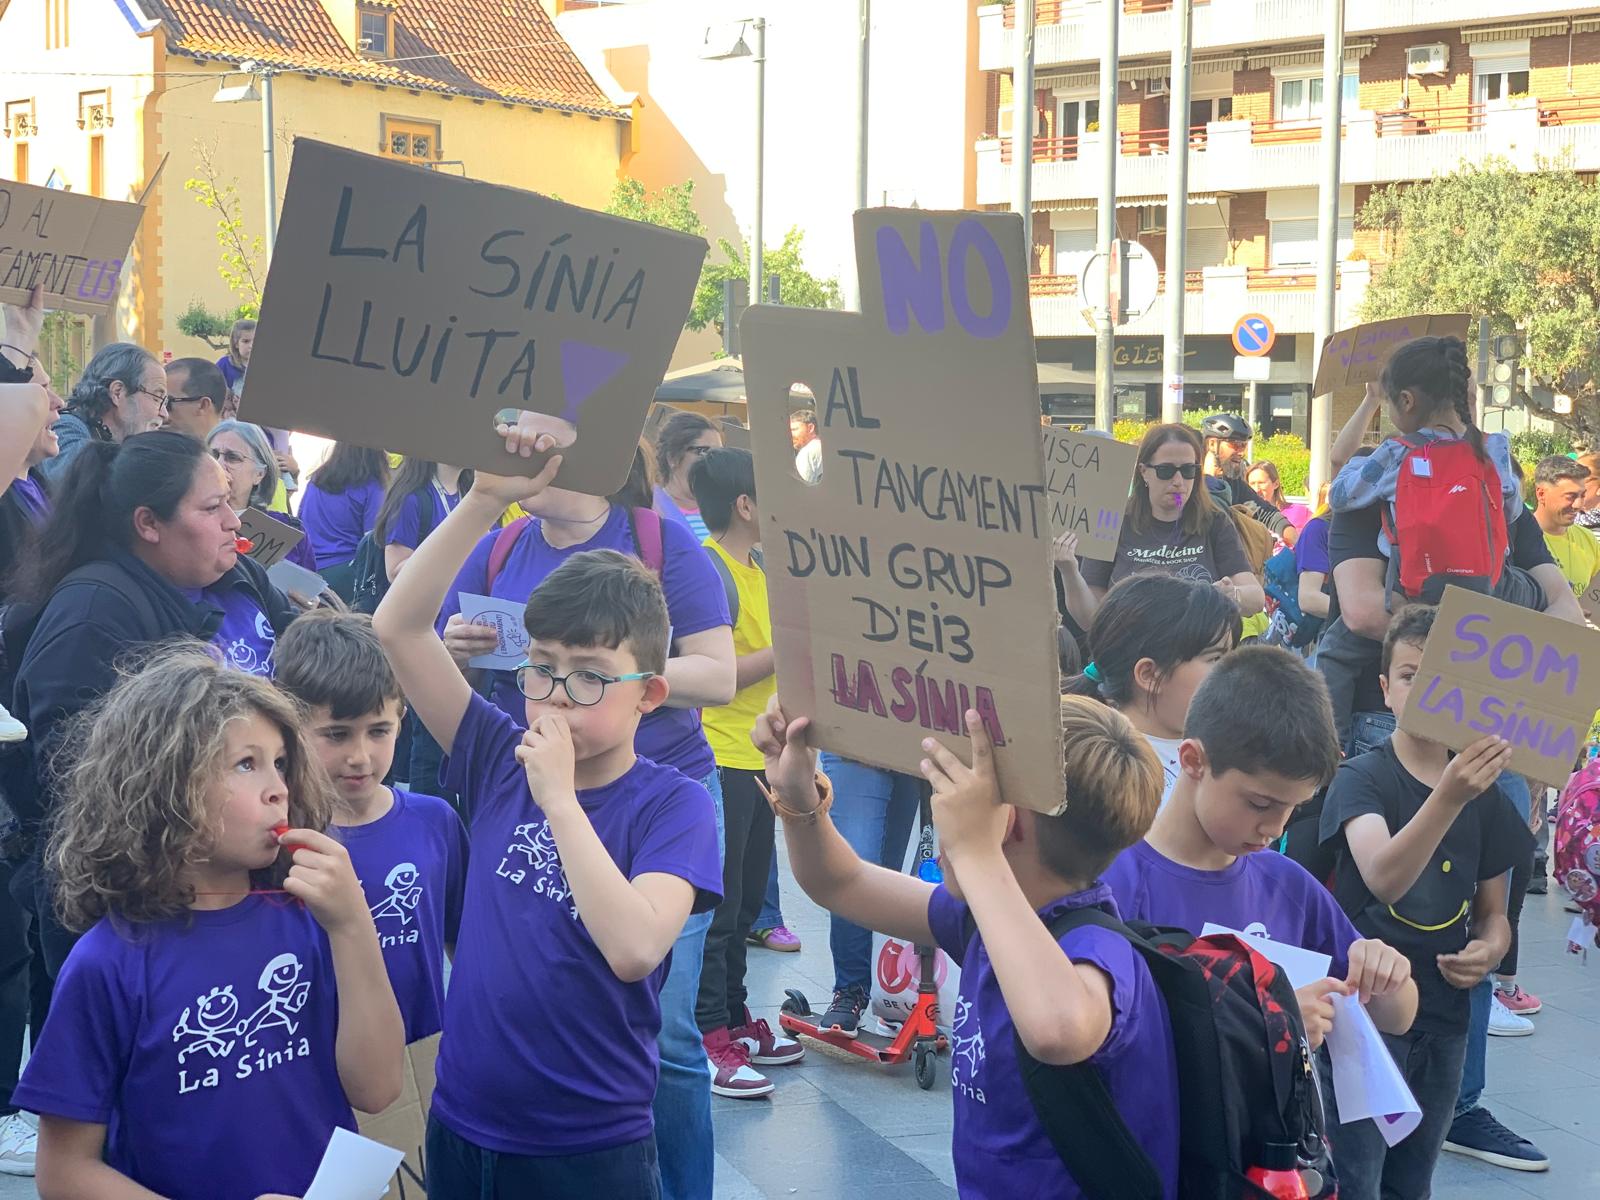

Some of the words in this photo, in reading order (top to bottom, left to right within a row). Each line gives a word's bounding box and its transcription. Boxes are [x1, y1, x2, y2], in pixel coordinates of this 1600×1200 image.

[23, 197, 54, 239] AL
[329, 186, 428, 273] LA
[876, 218, 1012, 339] NO
[823, 366, 881, 429] AL
[837, 449, 1045, 538] TANCAMENT
[1047, 468, 1076, 498] LA
[783, 527, 871, 578] D'UN
[888, 542, 1012, 607] GRUP
[1127, 544, 1204, 559] Madeleine
[1450, 613, 1580, 696] SOM
[831, 653, 888, 718] LA
[890, 659, 1006, 747] SÍNIA
[1417, 674, 1465, 724] LA
[495, 857, 526, 884] La
[883, 998, 900, 1010] BE
[178, 1068, 220, 1094] La
[235, 1037, 310, 1080] Sínia
